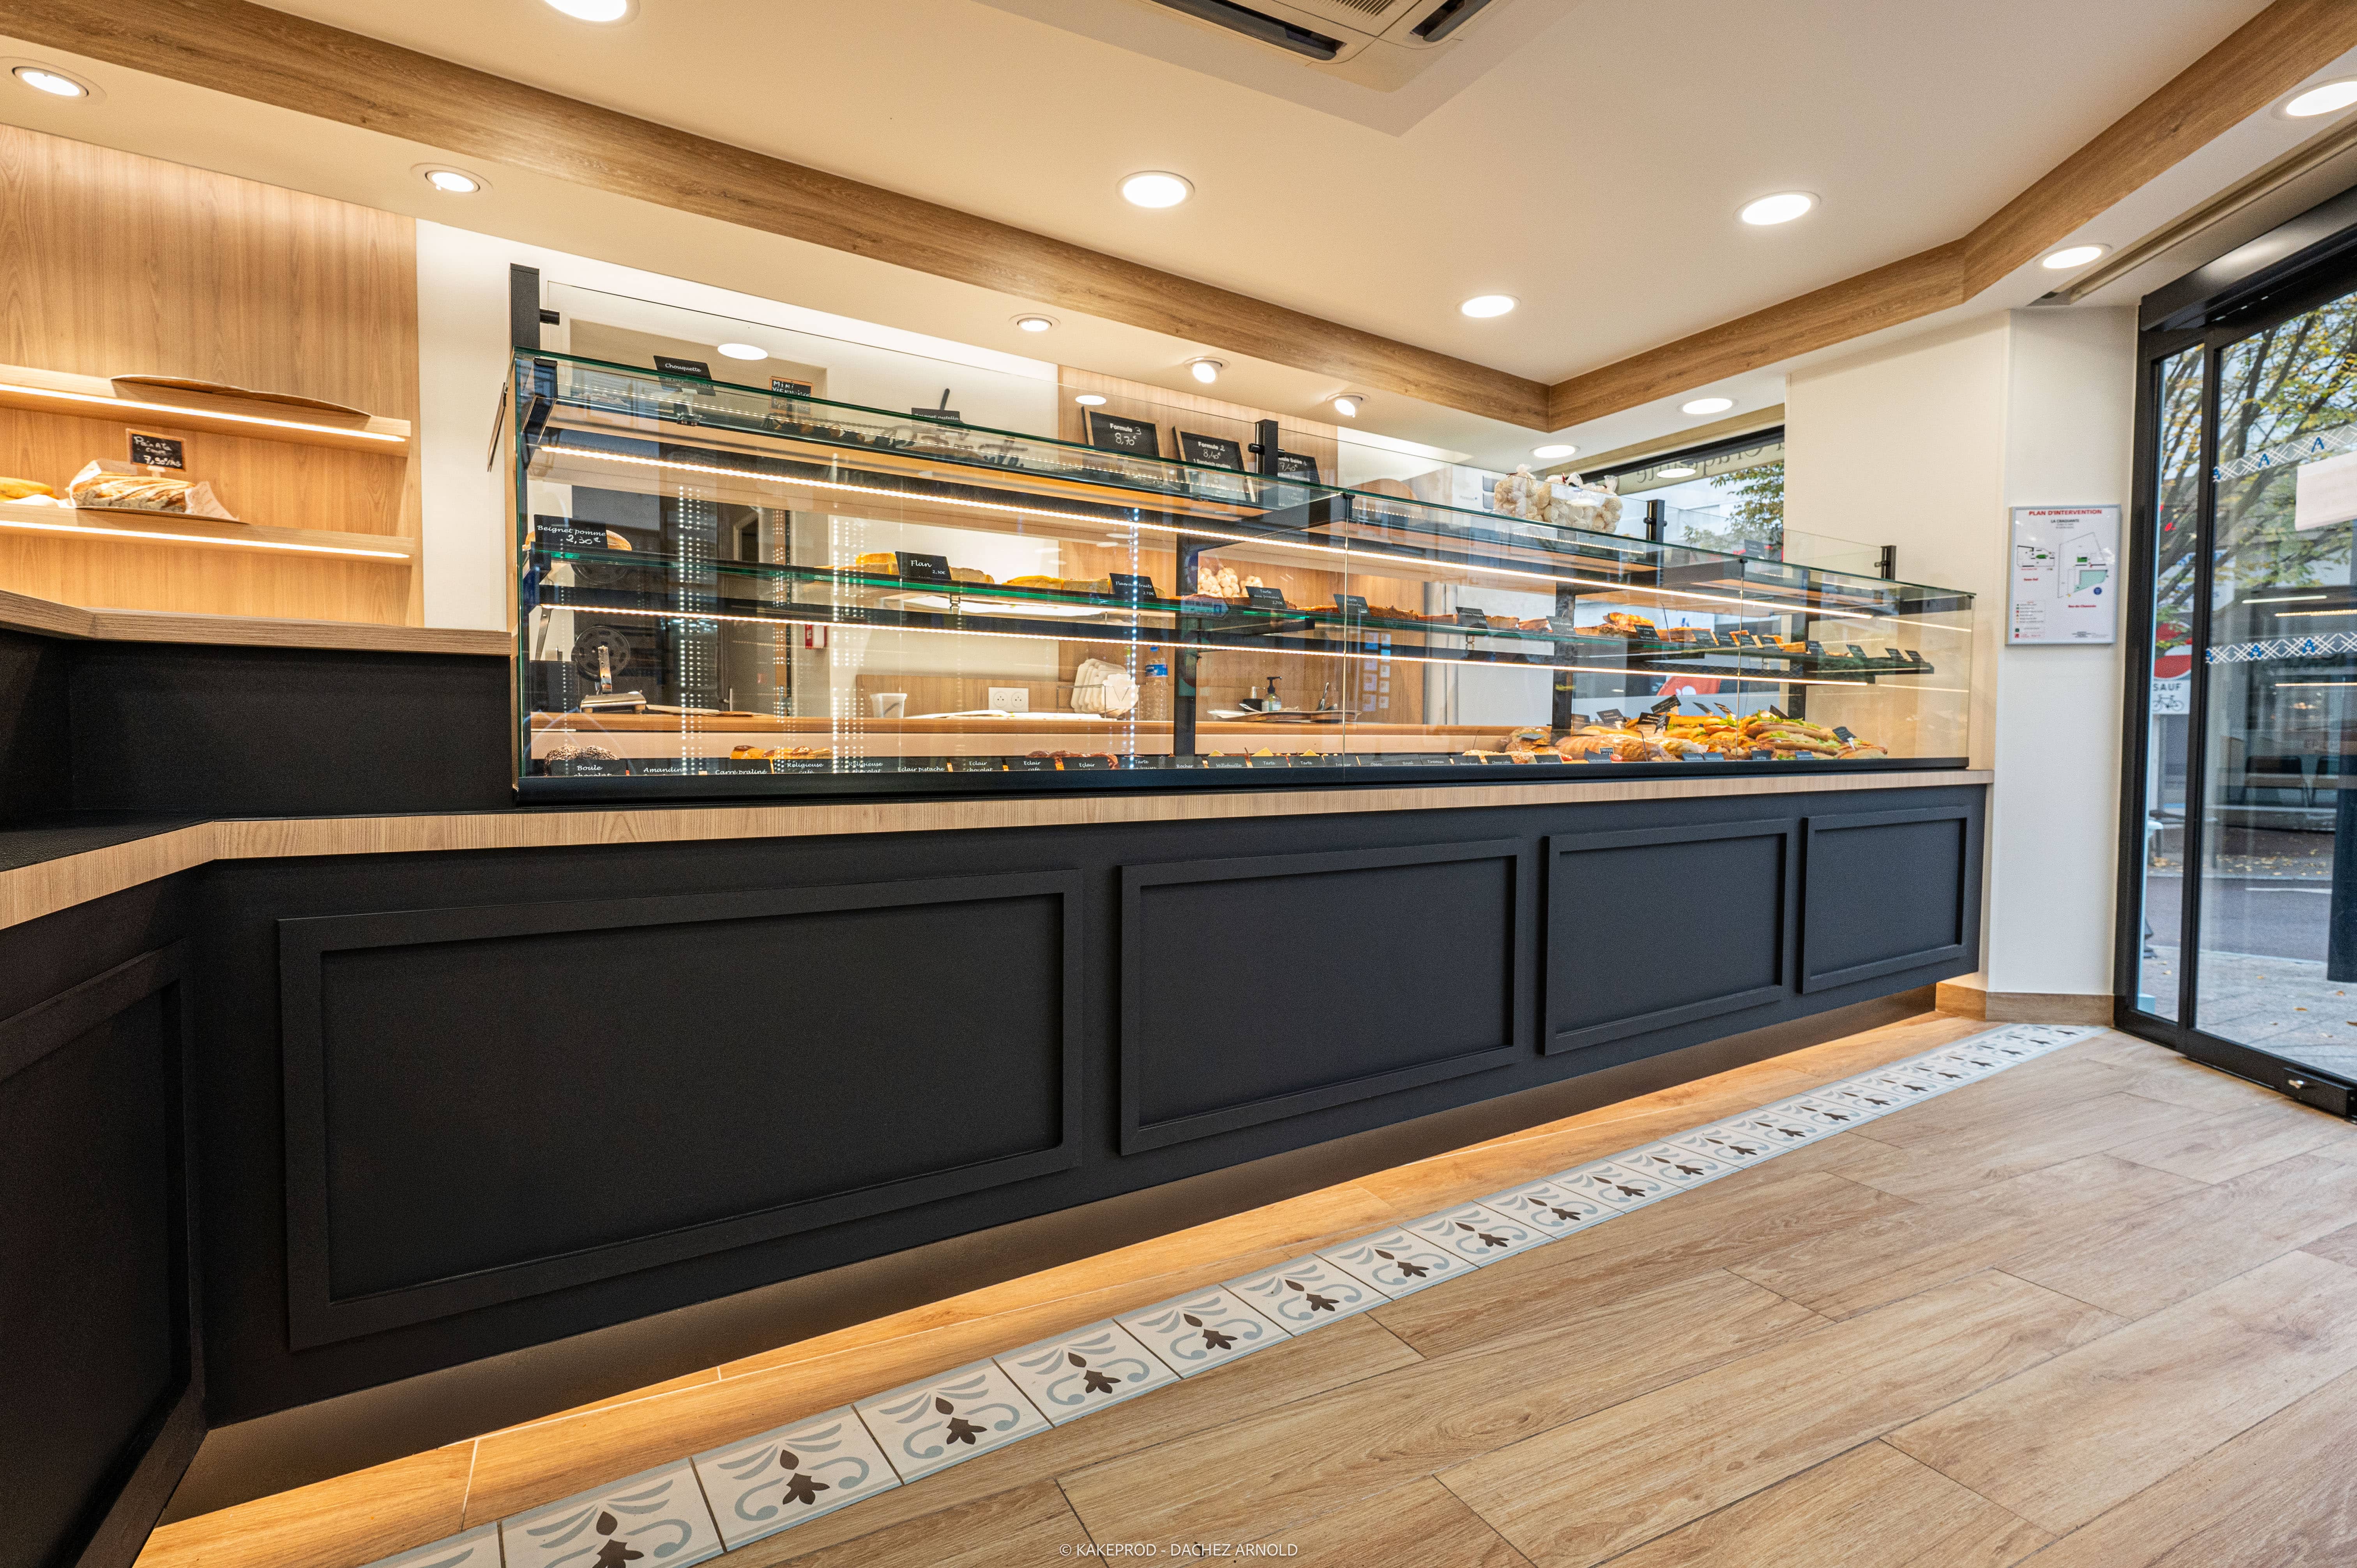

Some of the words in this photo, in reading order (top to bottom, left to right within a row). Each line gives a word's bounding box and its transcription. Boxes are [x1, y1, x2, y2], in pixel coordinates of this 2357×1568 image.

[665, 363, 701, 372] Chouquette
[1110, 423, 1133, 433] Formule
[1135, 427, 1141, 435] 3
[1198, 441, 1219, 450] Formule
[537, 525, 574, 533] Beignet
[566, 534, 601, 544] 2,30€
